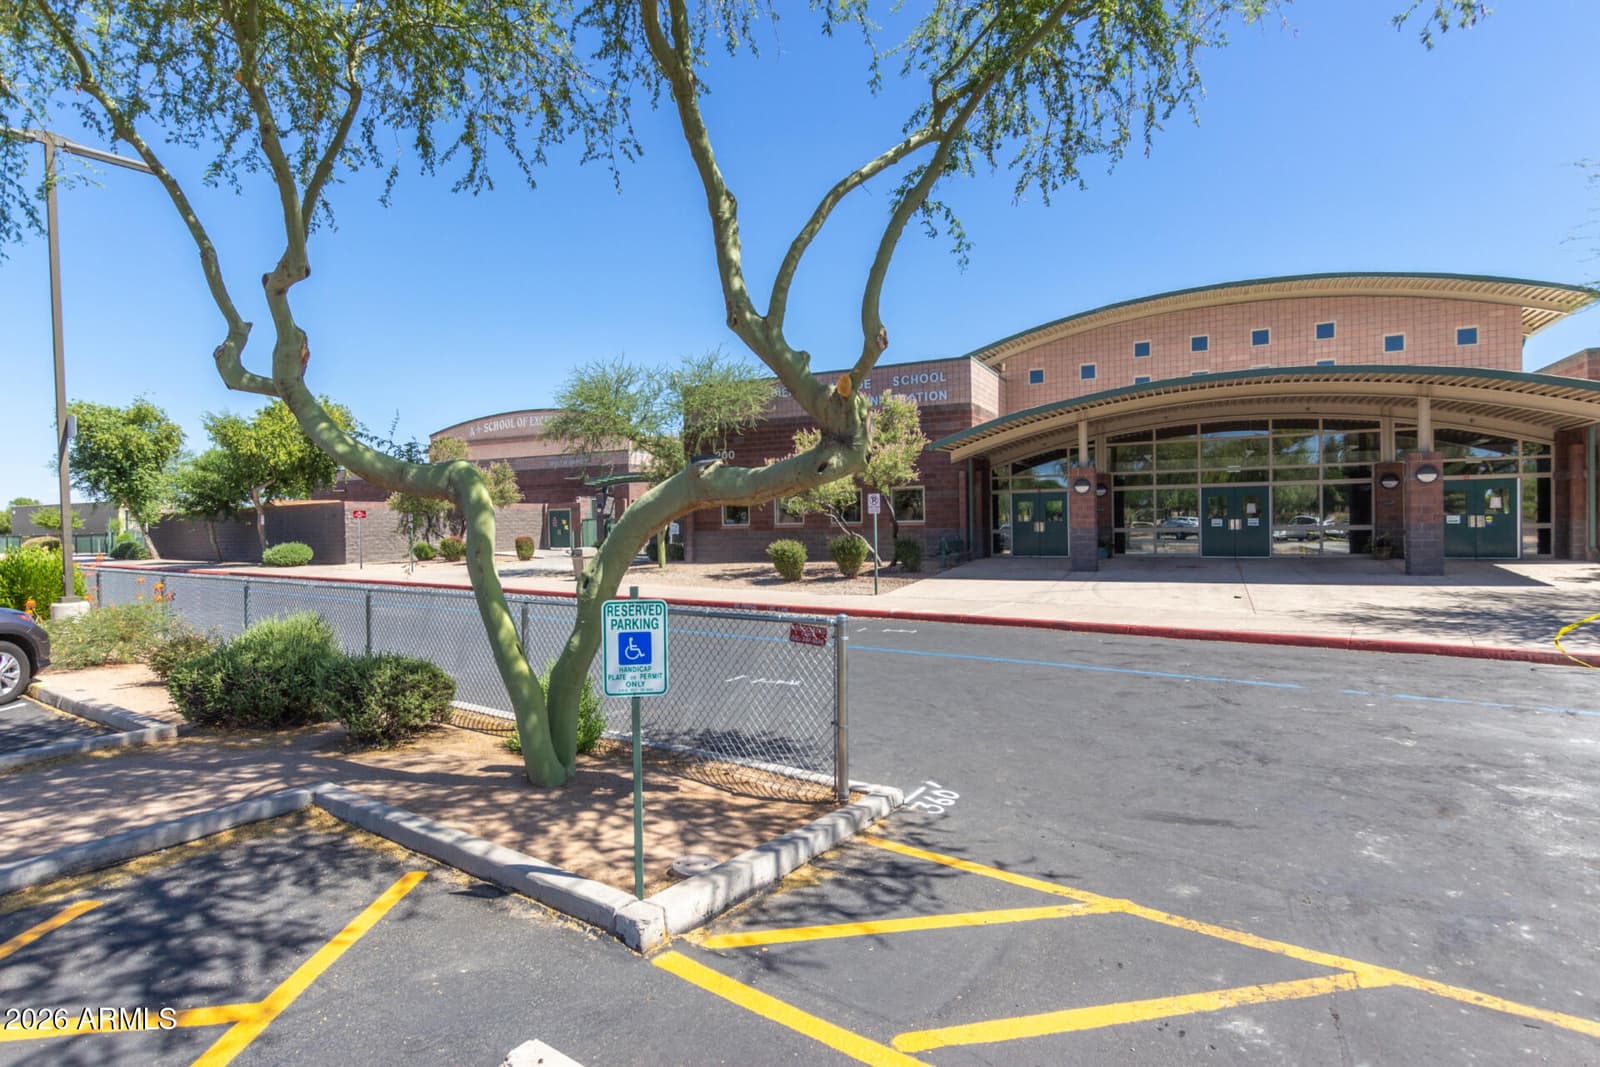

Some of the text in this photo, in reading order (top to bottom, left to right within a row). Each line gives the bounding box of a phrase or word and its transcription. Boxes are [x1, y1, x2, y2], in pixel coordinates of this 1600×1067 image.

[892, 371, 947, 387] SCHOOL
[483, 418, 516, 433] SCHOOL
[517, 416, 528, 428] OF
[607, 604, 662, 617] RESERVED
[611, 617, 659, 630] PARKING
[619, 665, 652, 673] HANDICAP
